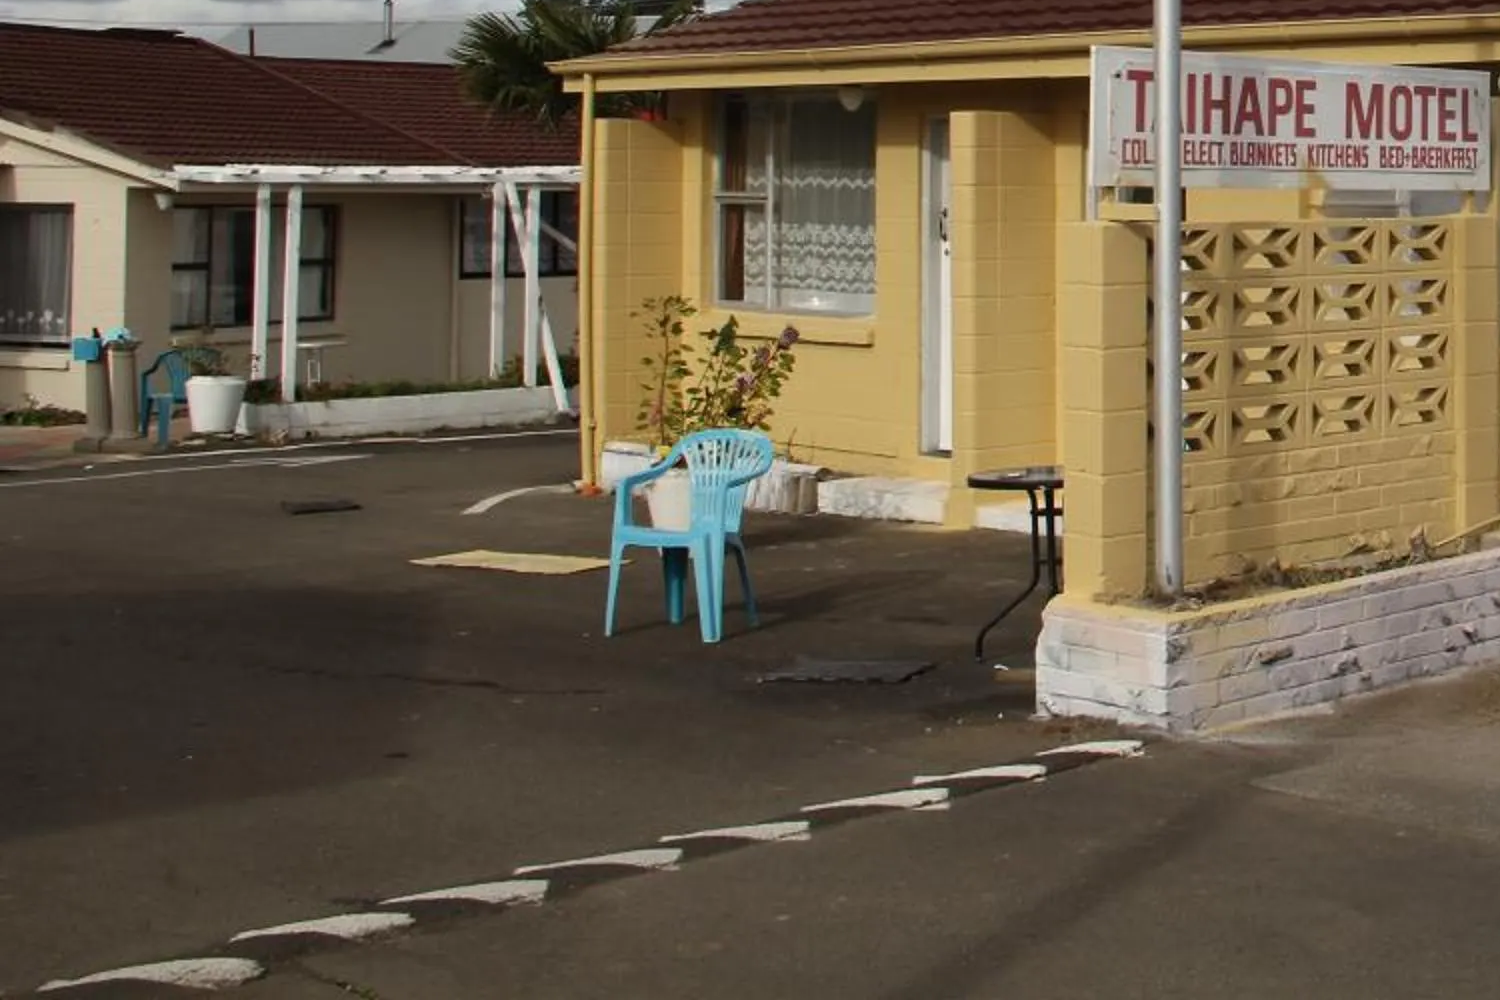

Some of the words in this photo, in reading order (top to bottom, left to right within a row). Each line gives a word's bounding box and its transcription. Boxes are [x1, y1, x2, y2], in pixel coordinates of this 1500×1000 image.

[1127, 71, 1317, 138] TIHAPE
[1346, 81, 1479, 143] MOTEL
[1230, 142, 1297, 166] BLANKETS
[1307, 144, 1369, 169] KITCHENS
